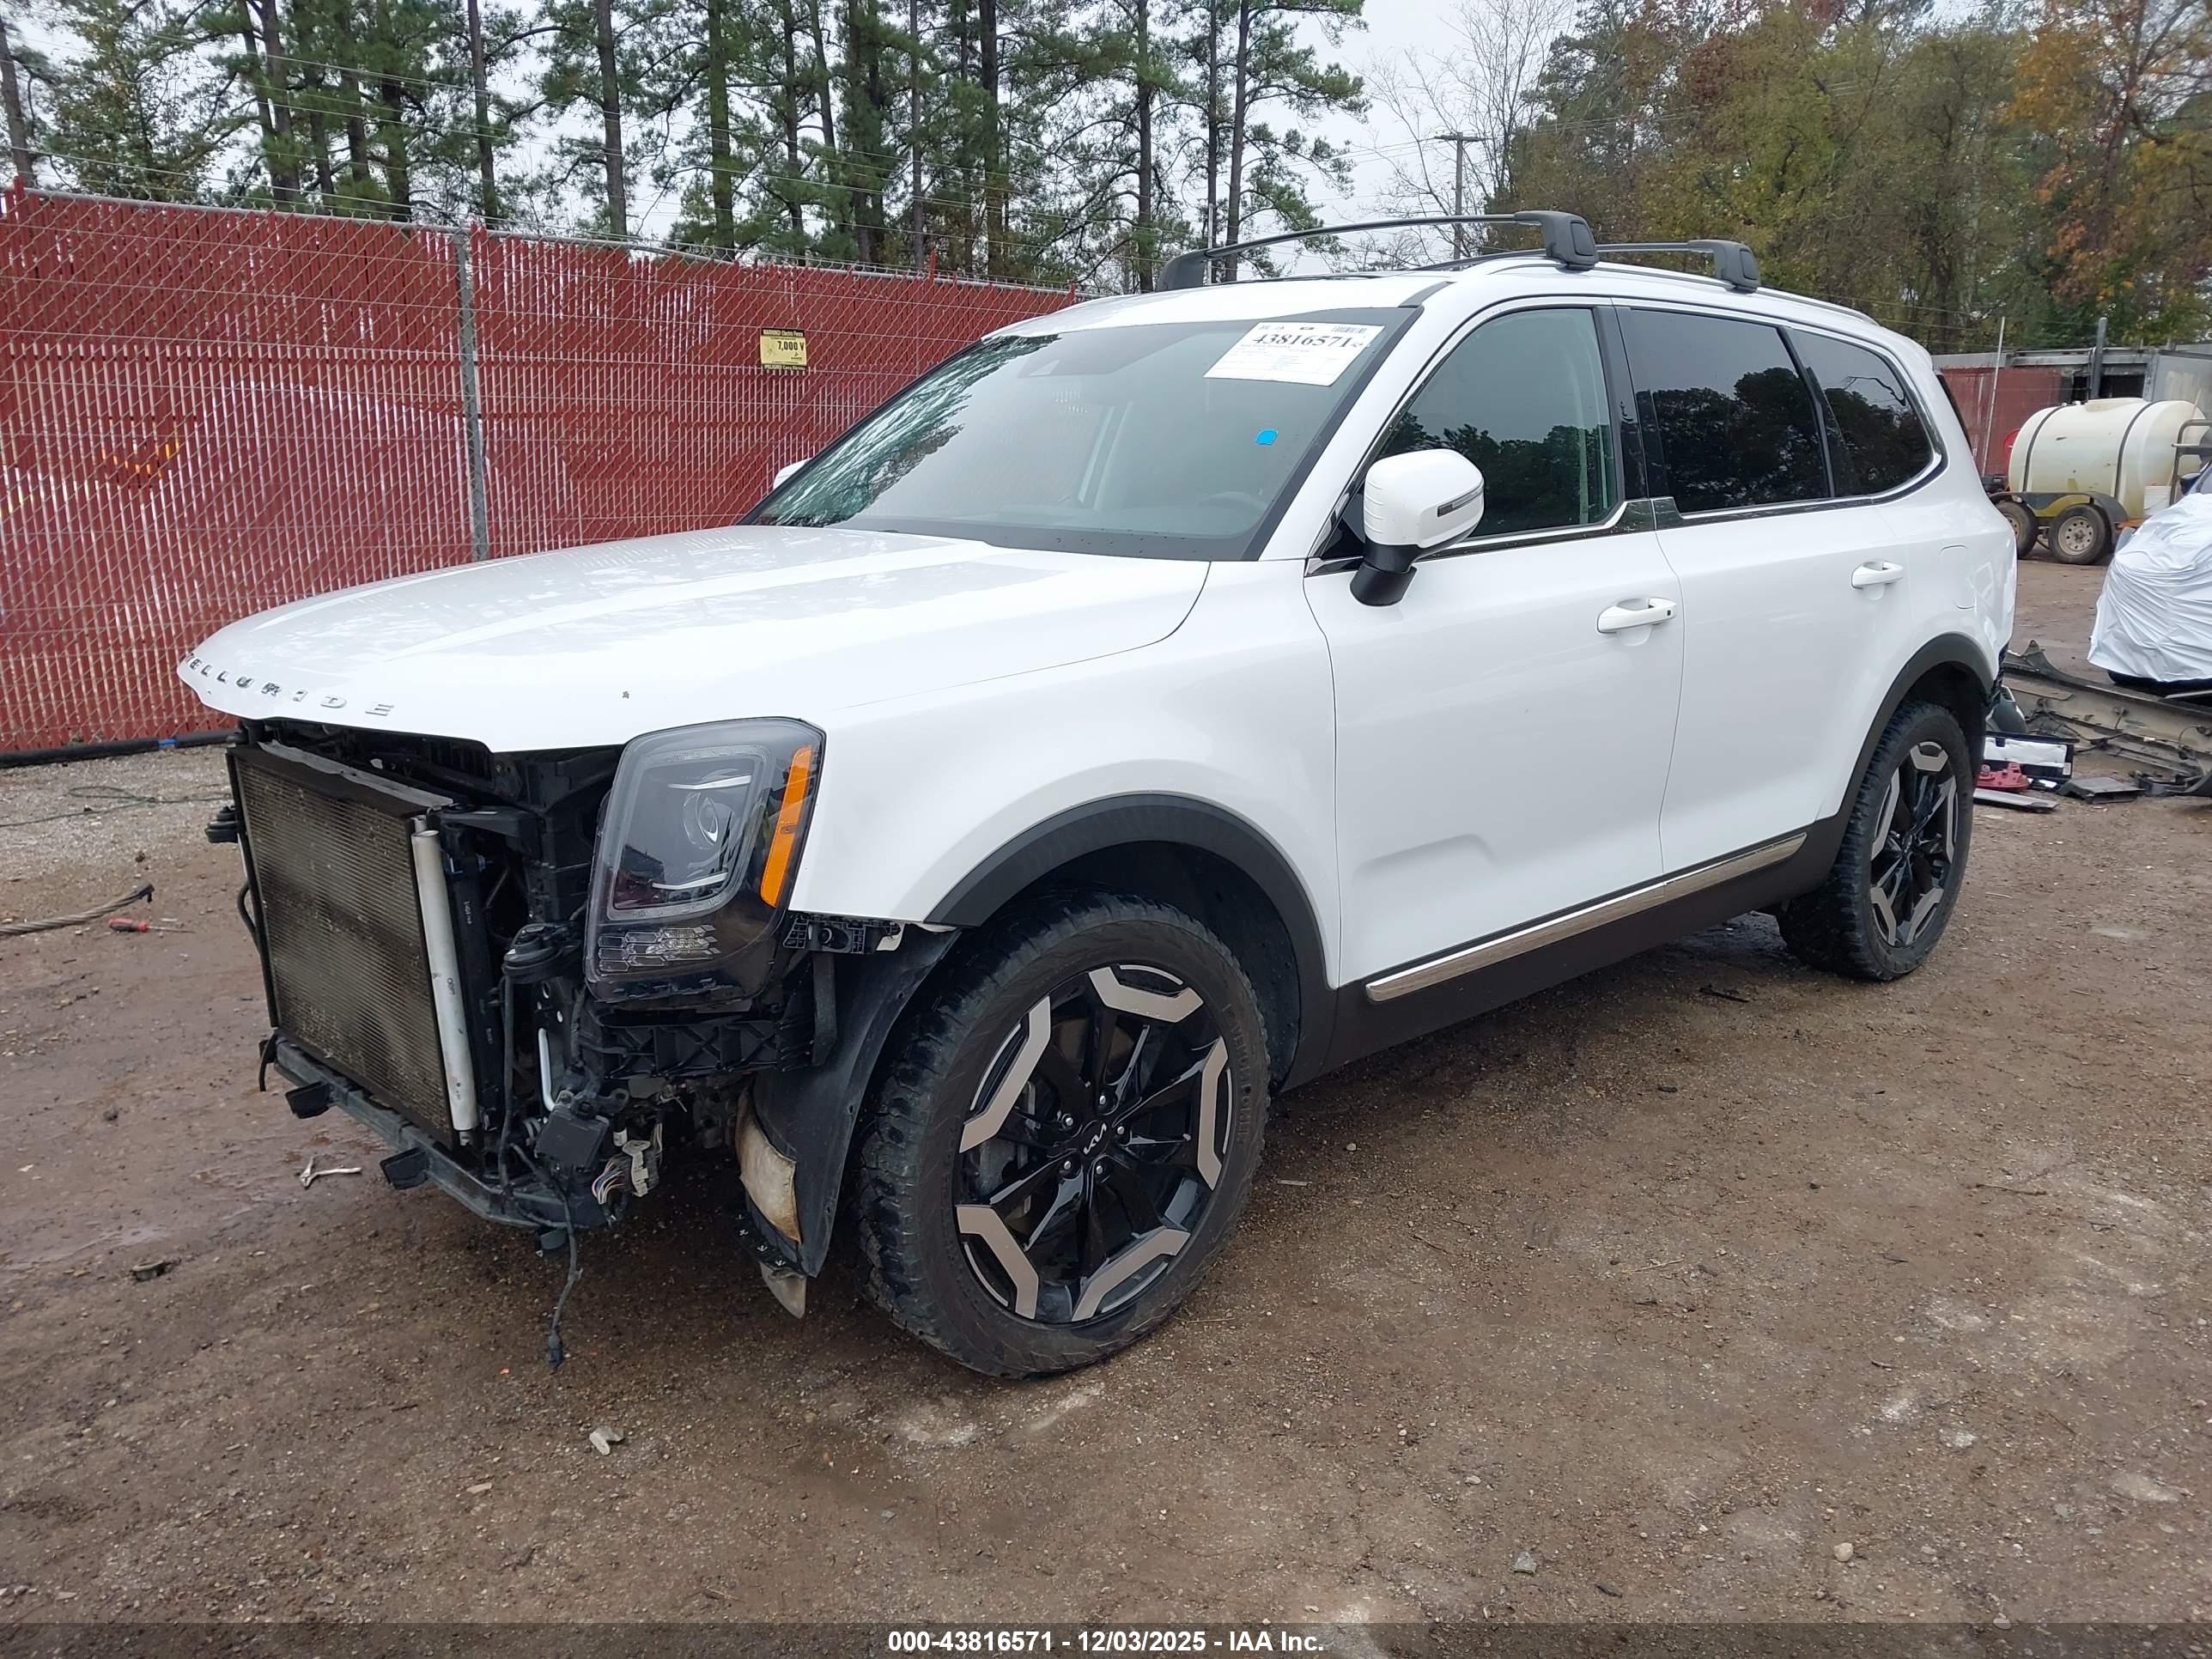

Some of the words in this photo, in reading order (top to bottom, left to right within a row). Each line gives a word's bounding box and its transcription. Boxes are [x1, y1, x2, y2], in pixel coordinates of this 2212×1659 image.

[777, 340, 799, 351] 7,000
[799, 342, 805, 351] V
[1252, 332, 1353, 348] 43816571
